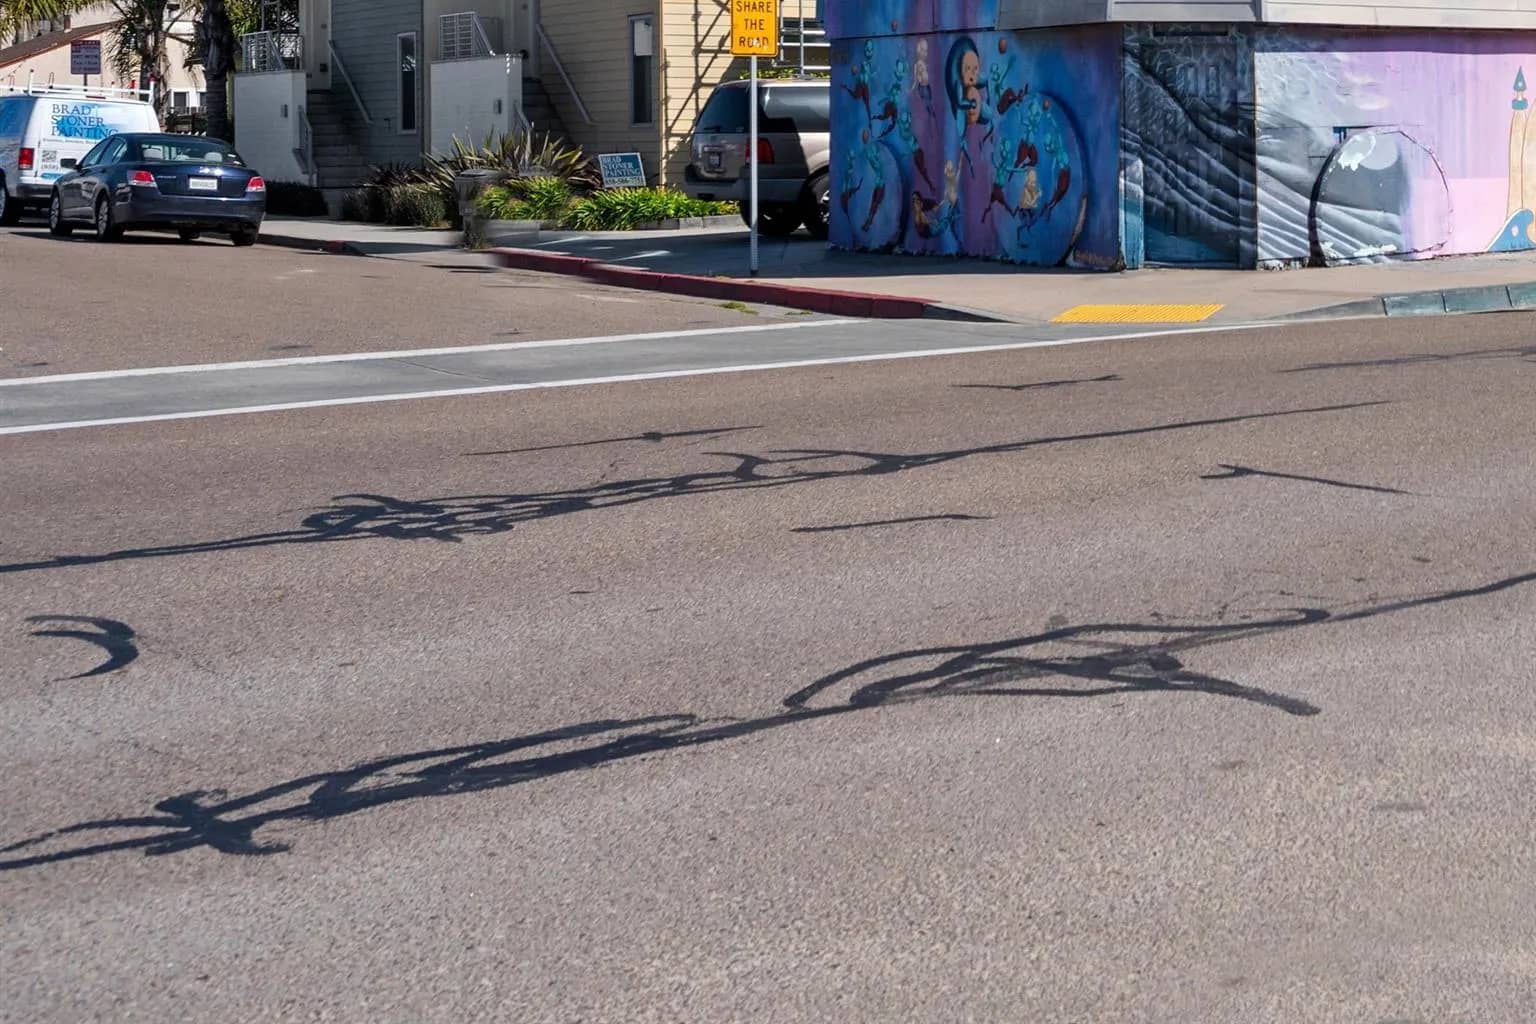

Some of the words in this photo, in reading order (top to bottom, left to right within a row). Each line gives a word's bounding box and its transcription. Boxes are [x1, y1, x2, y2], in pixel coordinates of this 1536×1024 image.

[736, 0, 773, 13] SHARE
[744, 18, 765, 31] THE
[52, 103, 92, 116] BRAD
[51, 114, 105, 128] STONER
[604, 168, 641, 177] PAINTING
